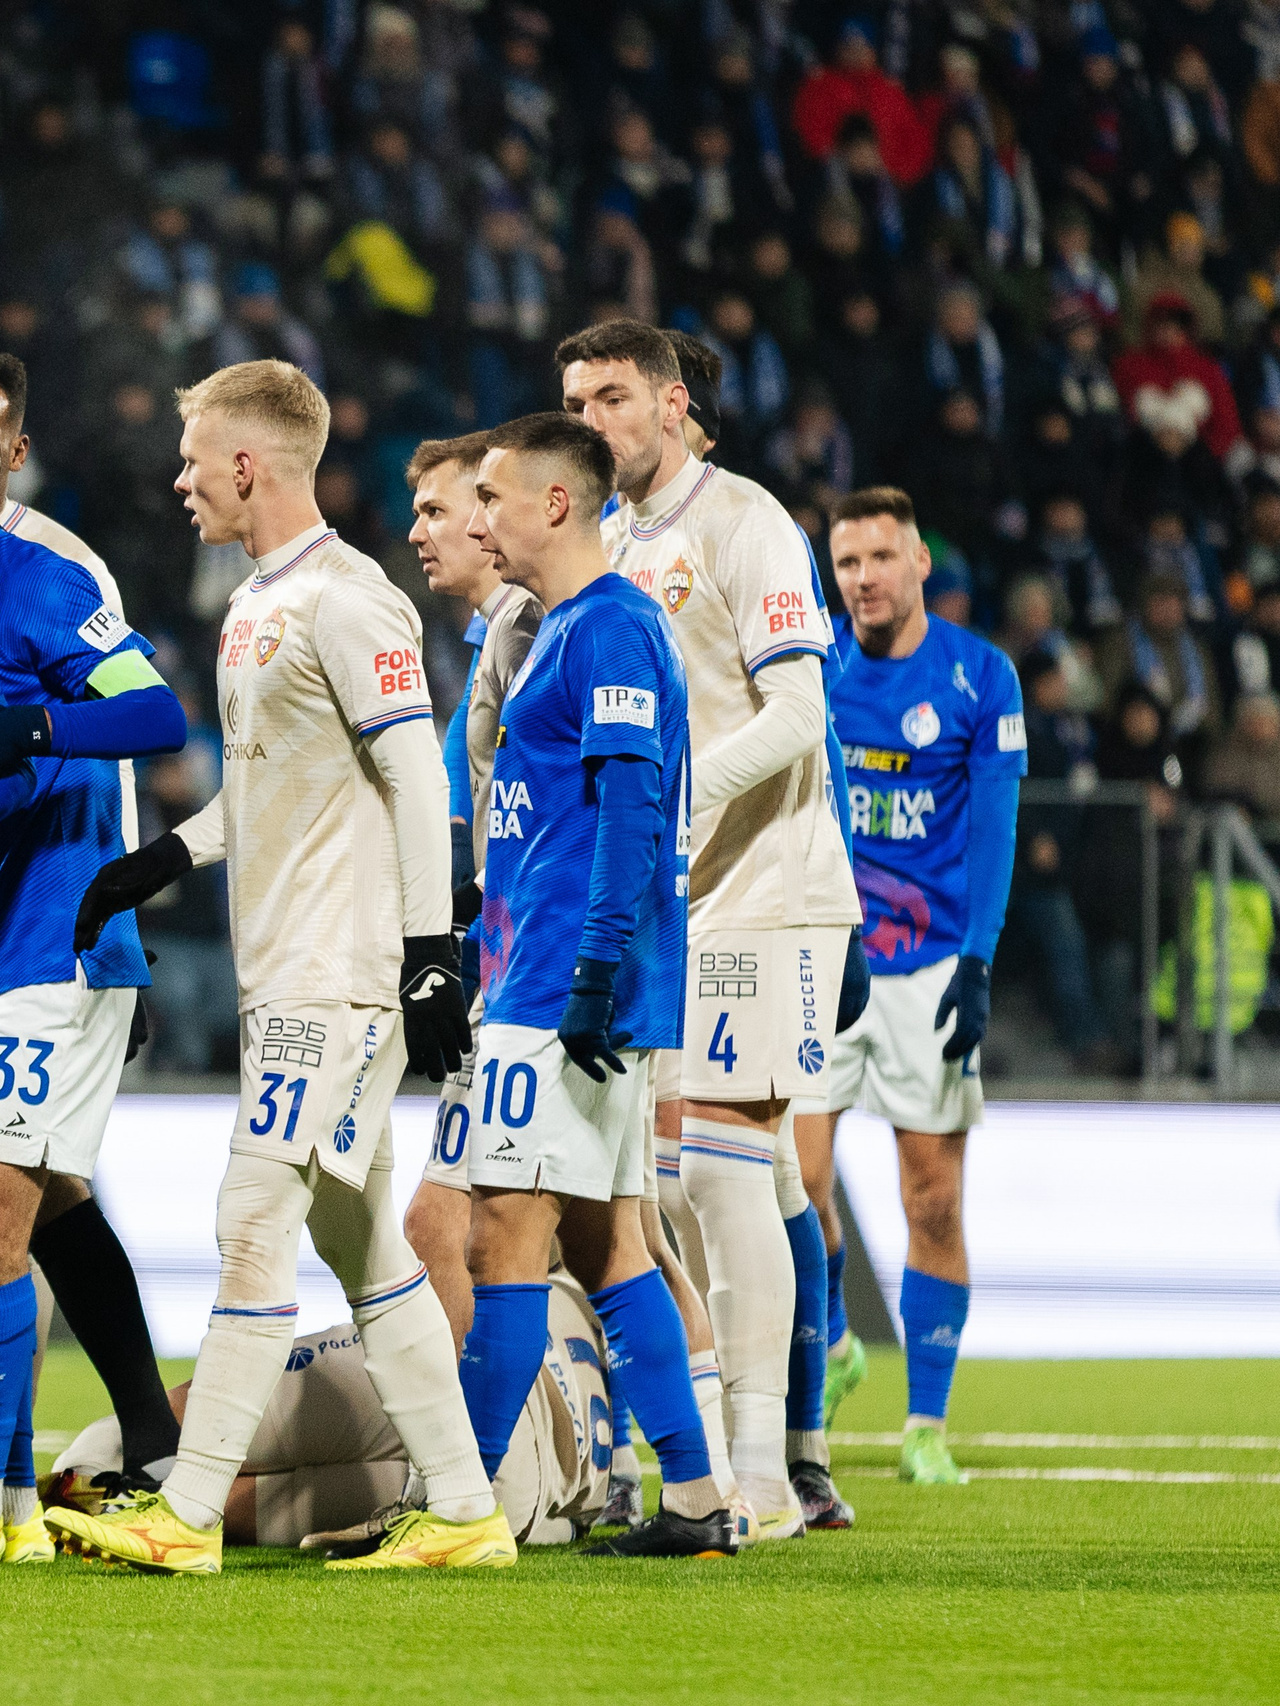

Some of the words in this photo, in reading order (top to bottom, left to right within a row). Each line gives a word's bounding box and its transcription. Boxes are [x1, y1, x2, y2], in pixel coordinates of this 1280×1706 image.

[763, 591, 803, 615] FON
[231, 619, 257, 641] FON
[769, 611, 807, 634] BET
[225, 643, 250, 668] BET
[374, 648, 418, 674] FON
[380, 668, 421, 695] BET
[842, 744, 910, 773] ЕЛБЕТ
[849, 784, 936, 817] ONIVA
[850, 809, 927, 840] НИВА
[699, 952, 758, 972] ВЭБ
[698, 980, 757, 1000] РФ
[799, 949, 817, 1031] РОССЕТИ
[264, 1017, 327, 1043] ВЭБ
[707, 1012, 738, 1074] 4
[260, 1044, 322, 1068] РФ
[349, 1023, 377, 1109] РОССЕТИ
[481, 1057, 538, 1129] 10
[249, 1072, 308, 1142] 31
[432, 1099, 470, 1165] 10
[485, 1153, 524, 1163] DEMIX
[318, 1332, 361, 1355] РОСС
